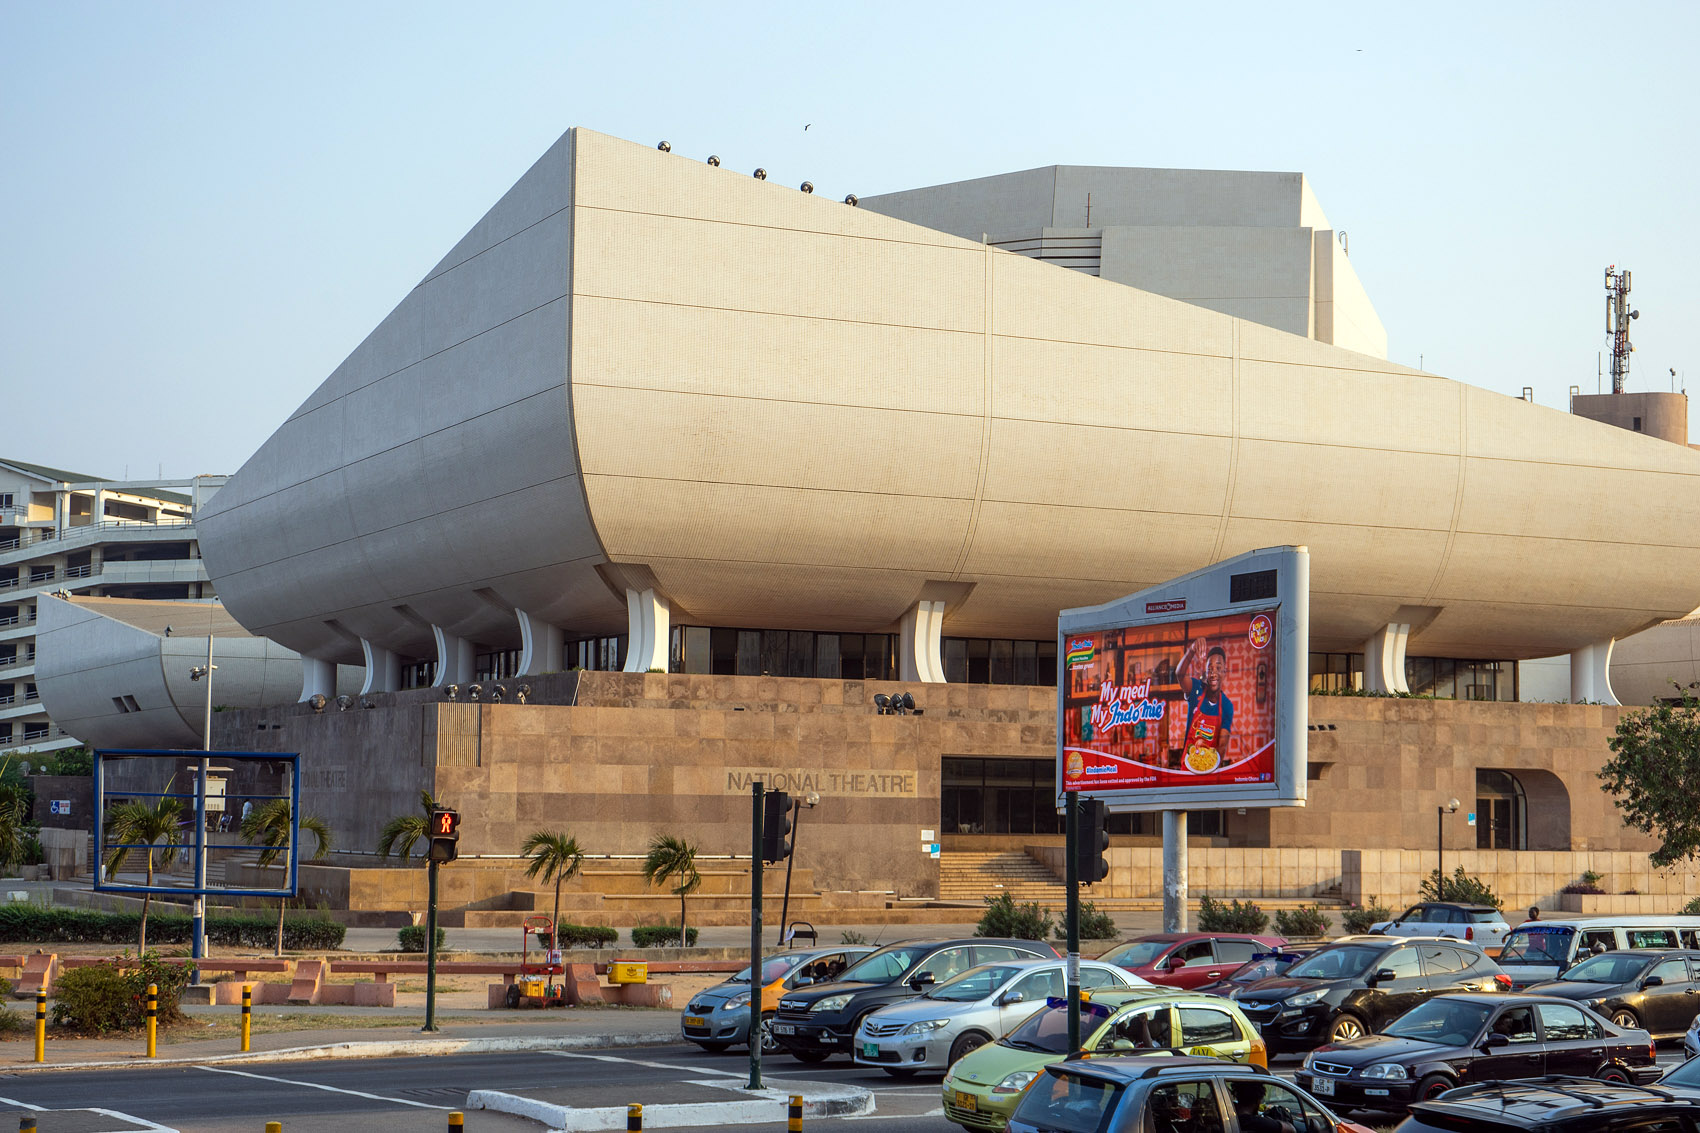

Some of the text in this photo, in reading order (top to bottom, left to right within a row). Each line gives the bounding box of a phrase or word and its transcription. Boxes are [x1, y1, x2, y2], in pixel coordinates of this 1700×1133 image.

[1252, 621, 1265, 632] Love
[1100, 678, 1151, 706] My meal
[1091, 704, 1108, 728] My
[727, 772, 915, 794] NATIONAL THEATRE
